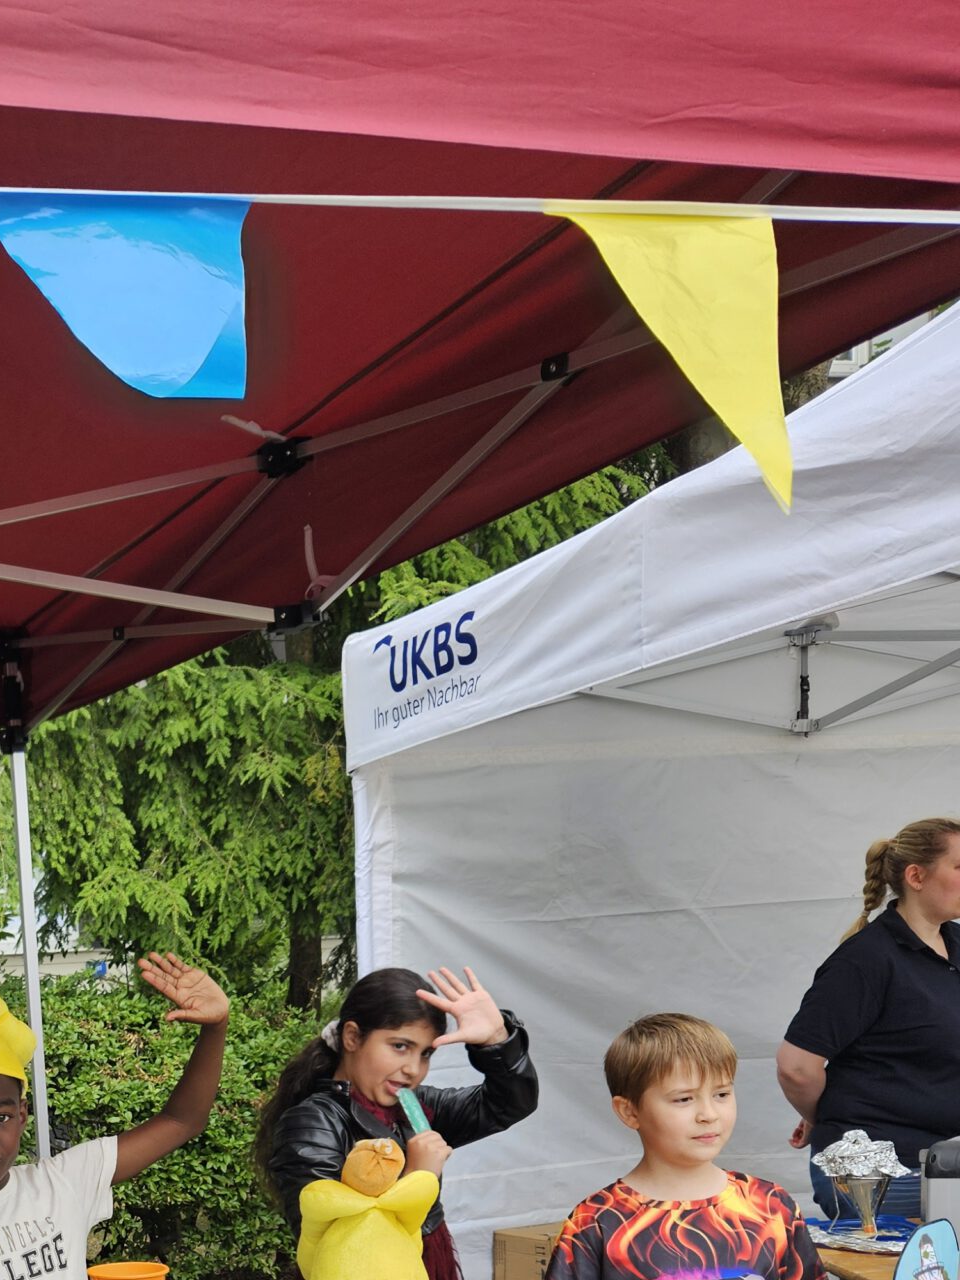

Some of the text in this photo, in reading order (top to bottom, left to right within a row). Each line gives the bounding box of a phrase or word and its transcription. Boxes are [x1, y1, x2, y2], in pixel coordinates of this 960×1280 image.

[389, 611, 478, 693] UKBS
[373, 674, 482, 730] Ihr guter Nachbar
